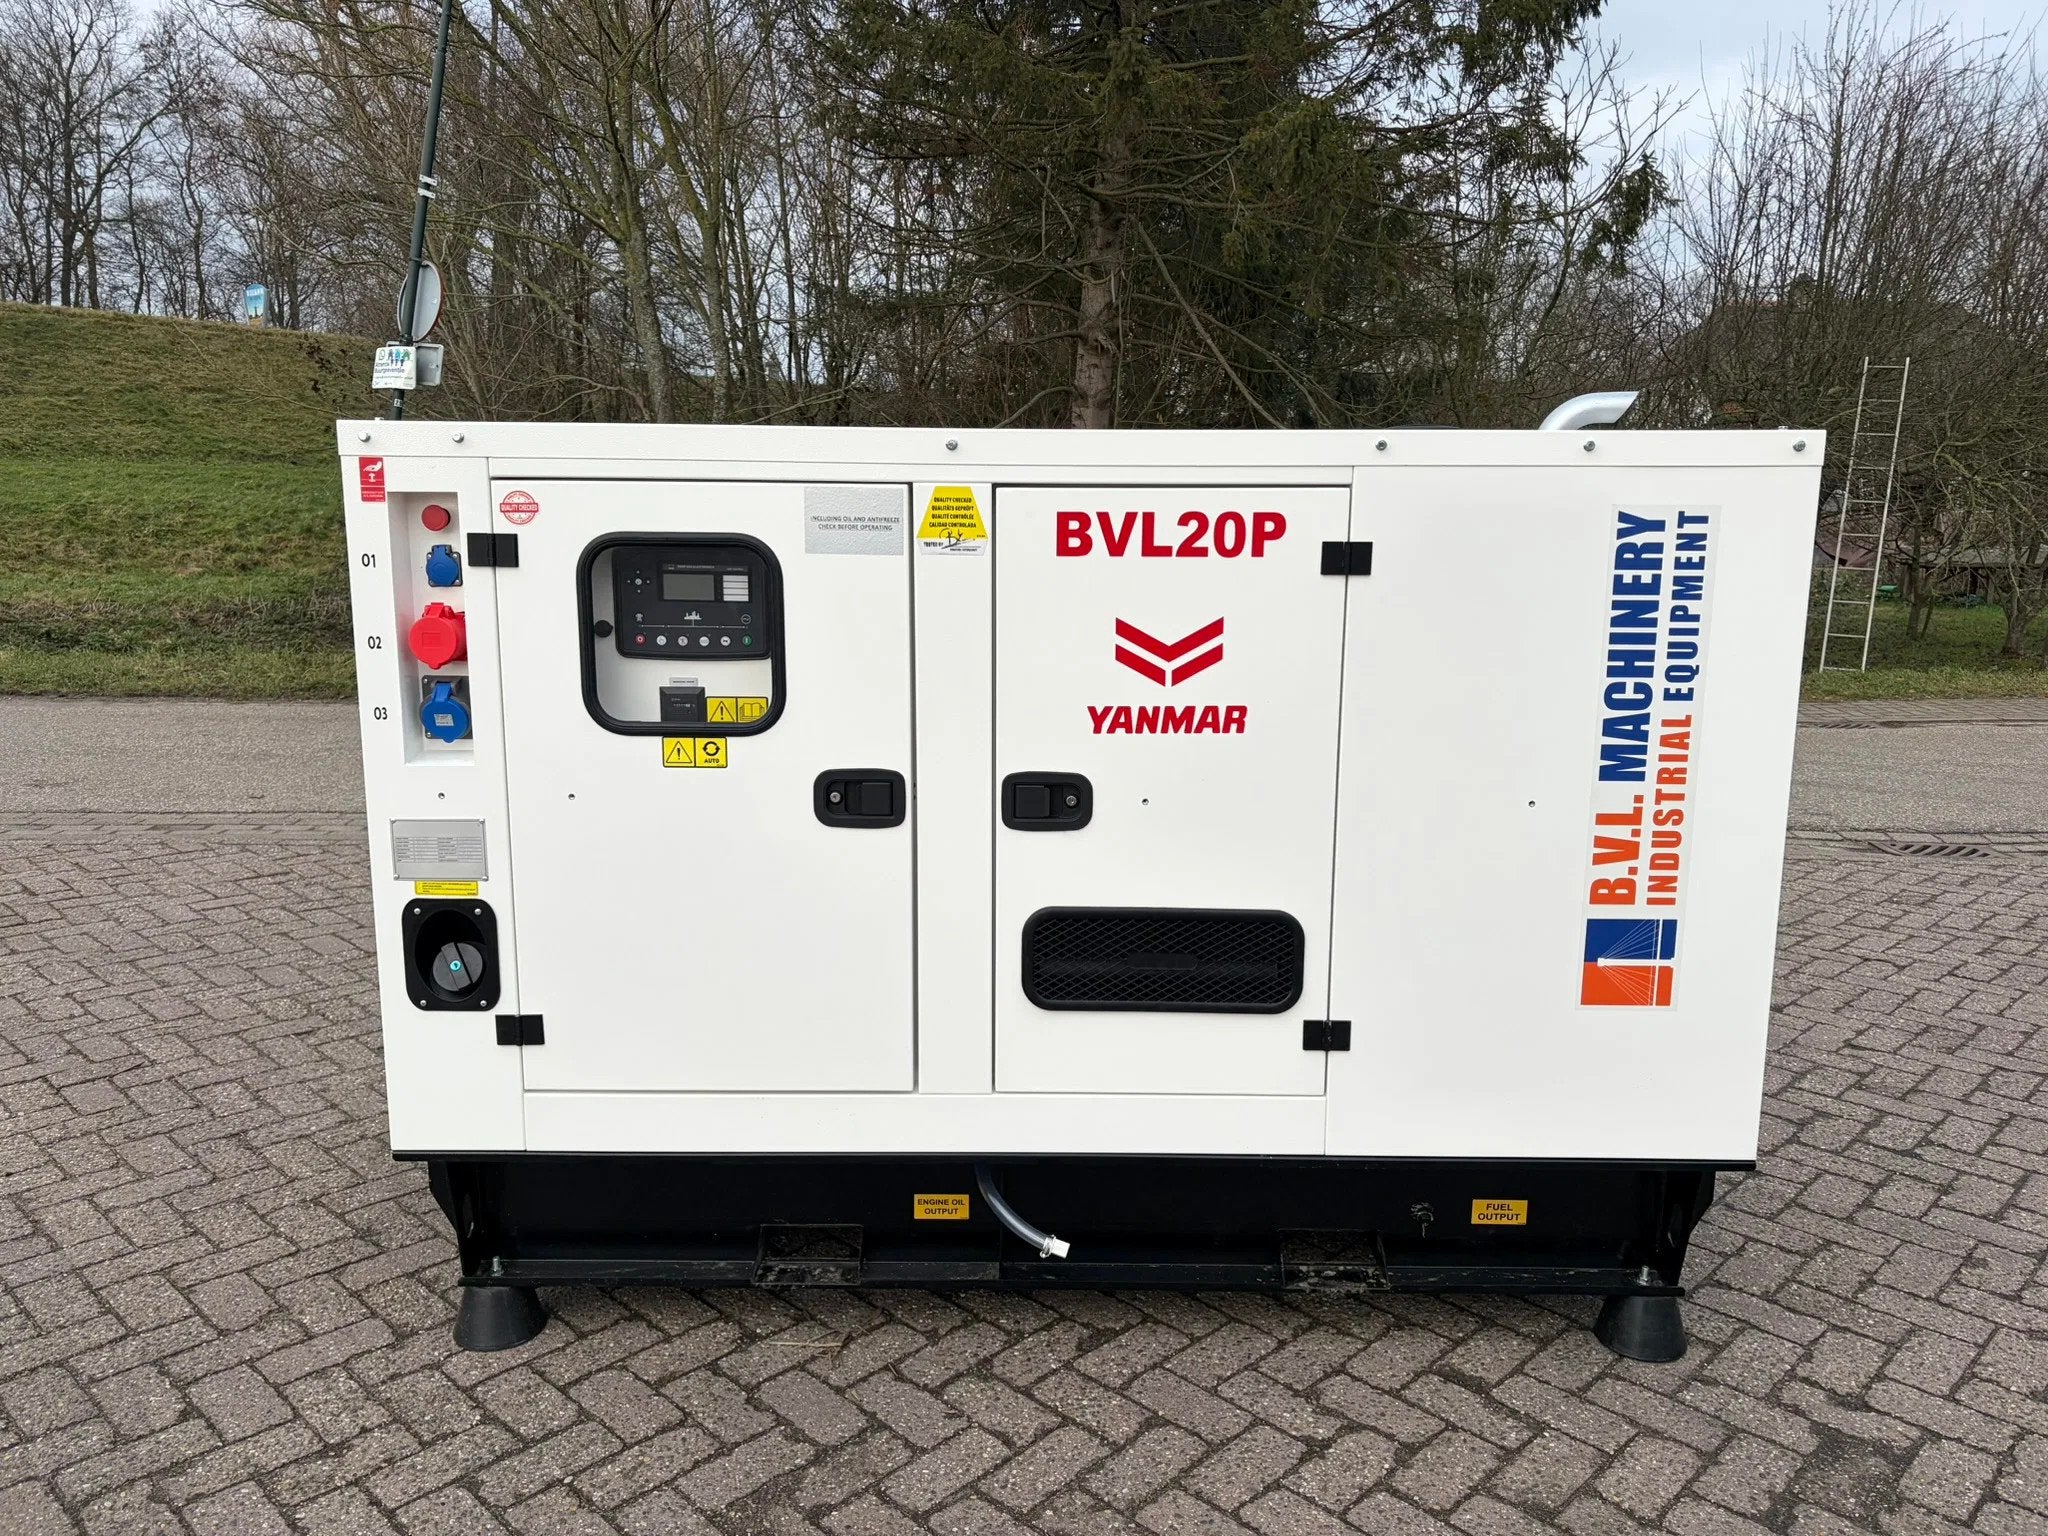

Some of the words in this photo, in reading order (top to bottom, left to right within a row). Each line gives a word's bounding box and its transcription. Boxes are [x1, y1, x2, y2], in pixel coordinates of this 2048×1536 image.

[1056, 511, 1287, 558] BVL20P
[361, 553, 376, 568] 01
[1663, 510, 1709, 701] EQUIPMENT
[367, 636, 382, 650] 02
[1598, 510, 1666, 782] MACHINERY
[373, 707, 388, 720] 03
[1087, 705, 1248, 734] YANMAR
[1646, 714, 1692, 905] INDUSTRIAL
[1589, 794, 1644, 905] B.V.L.
[917, 1198, 949, 1206] ENGINE
[951, 1198, 966, 1206] OIL
[1486, 1203, 1513, 1211] FUEL
[924, 1207, 959, 1215] OUTPUT
[1477, 1212, 1521, 1221] OUTPUT
